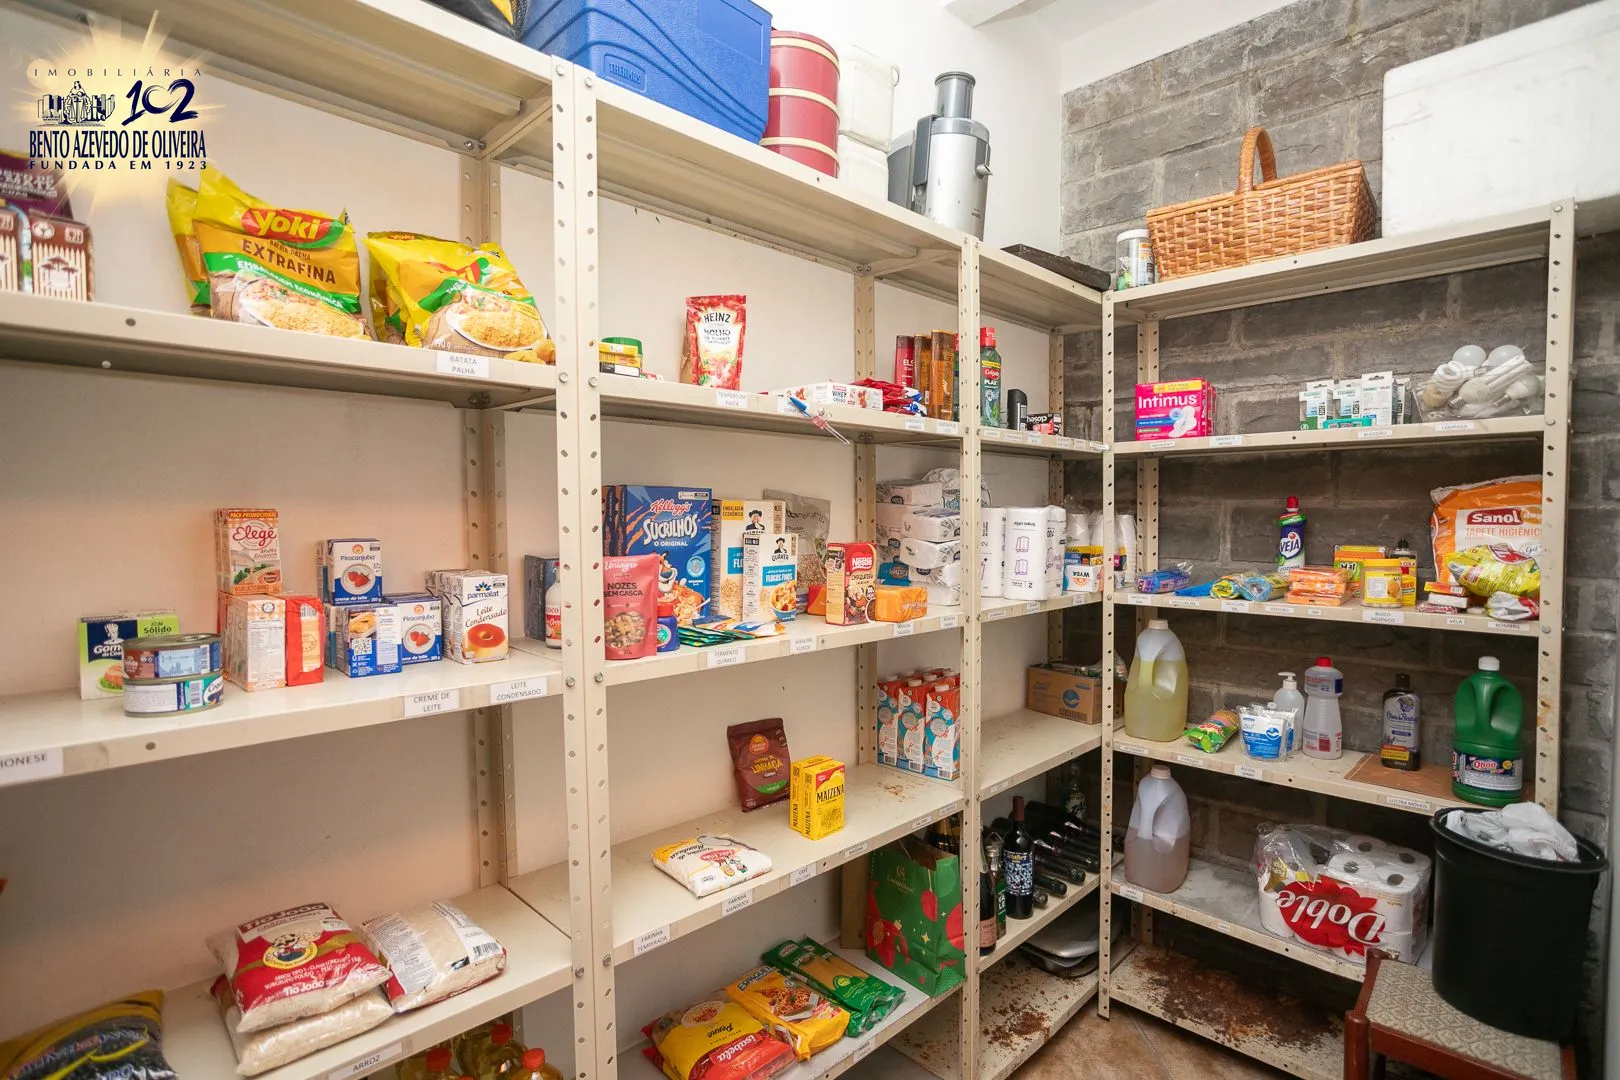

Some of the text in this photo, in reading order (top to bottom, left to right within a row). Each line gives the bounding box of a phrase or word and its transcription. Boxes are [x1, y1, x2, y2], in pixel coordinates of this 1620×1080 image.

[242, 238, 337, 285] EXTRAFINA
[704, 312, 732, 324] HEINZ
[449, 355, 478, 366] BATATA
[452, 366, 475, 375] PALHA
[1138, 393, 1198, 409] Intimus
[650, 499, 692, 516] Kellogg's
[1471, 510, 1520, 524] Sanol
[232, 526, 277, 547] Elegê
[642, 515, 699, 545] SUCRILHOS
[1466, 527, 1542, 536] TAPETE HIGIÊNIC
[1279, 539, 1300, 552] VEJA
[340, 554, 375, 562] Piracanjuba
[607, 582, 638, 590] NOZES
[467, 589, 499, 600] parmalat
[476, 605, 493, 617] Leite
[465, 609, 508, 628] Condensado
[143, 625, 172, 634] Sólido
[93, 644, 123, 654] Gom
[714, 649, 739, 658] FERMENTO
[510, 681, 527, 690] LEITE
[413, 691, 451, 704] CREME DE
[496, 688, 542, 701] CONDENSADO
[423, 704, 441, 713] LEITE
[751, 760, 783, 775] LINHAÇA
[816, 784, 845, 804] MAIZENA
[728, 894, 747, 905] FARINHA
[1277, 889, 1386, 943] Doble
[640, 929, 663, 943] FARINHA
[637, 935, 667, 953] TEMPERADA
[284, 979, 325, 997] Tio João
[706, 1022, 735, 1039] Penne
[716, 1033, 757, 1062] isabela
[352, 1054, 381, 1073] ARROZ
